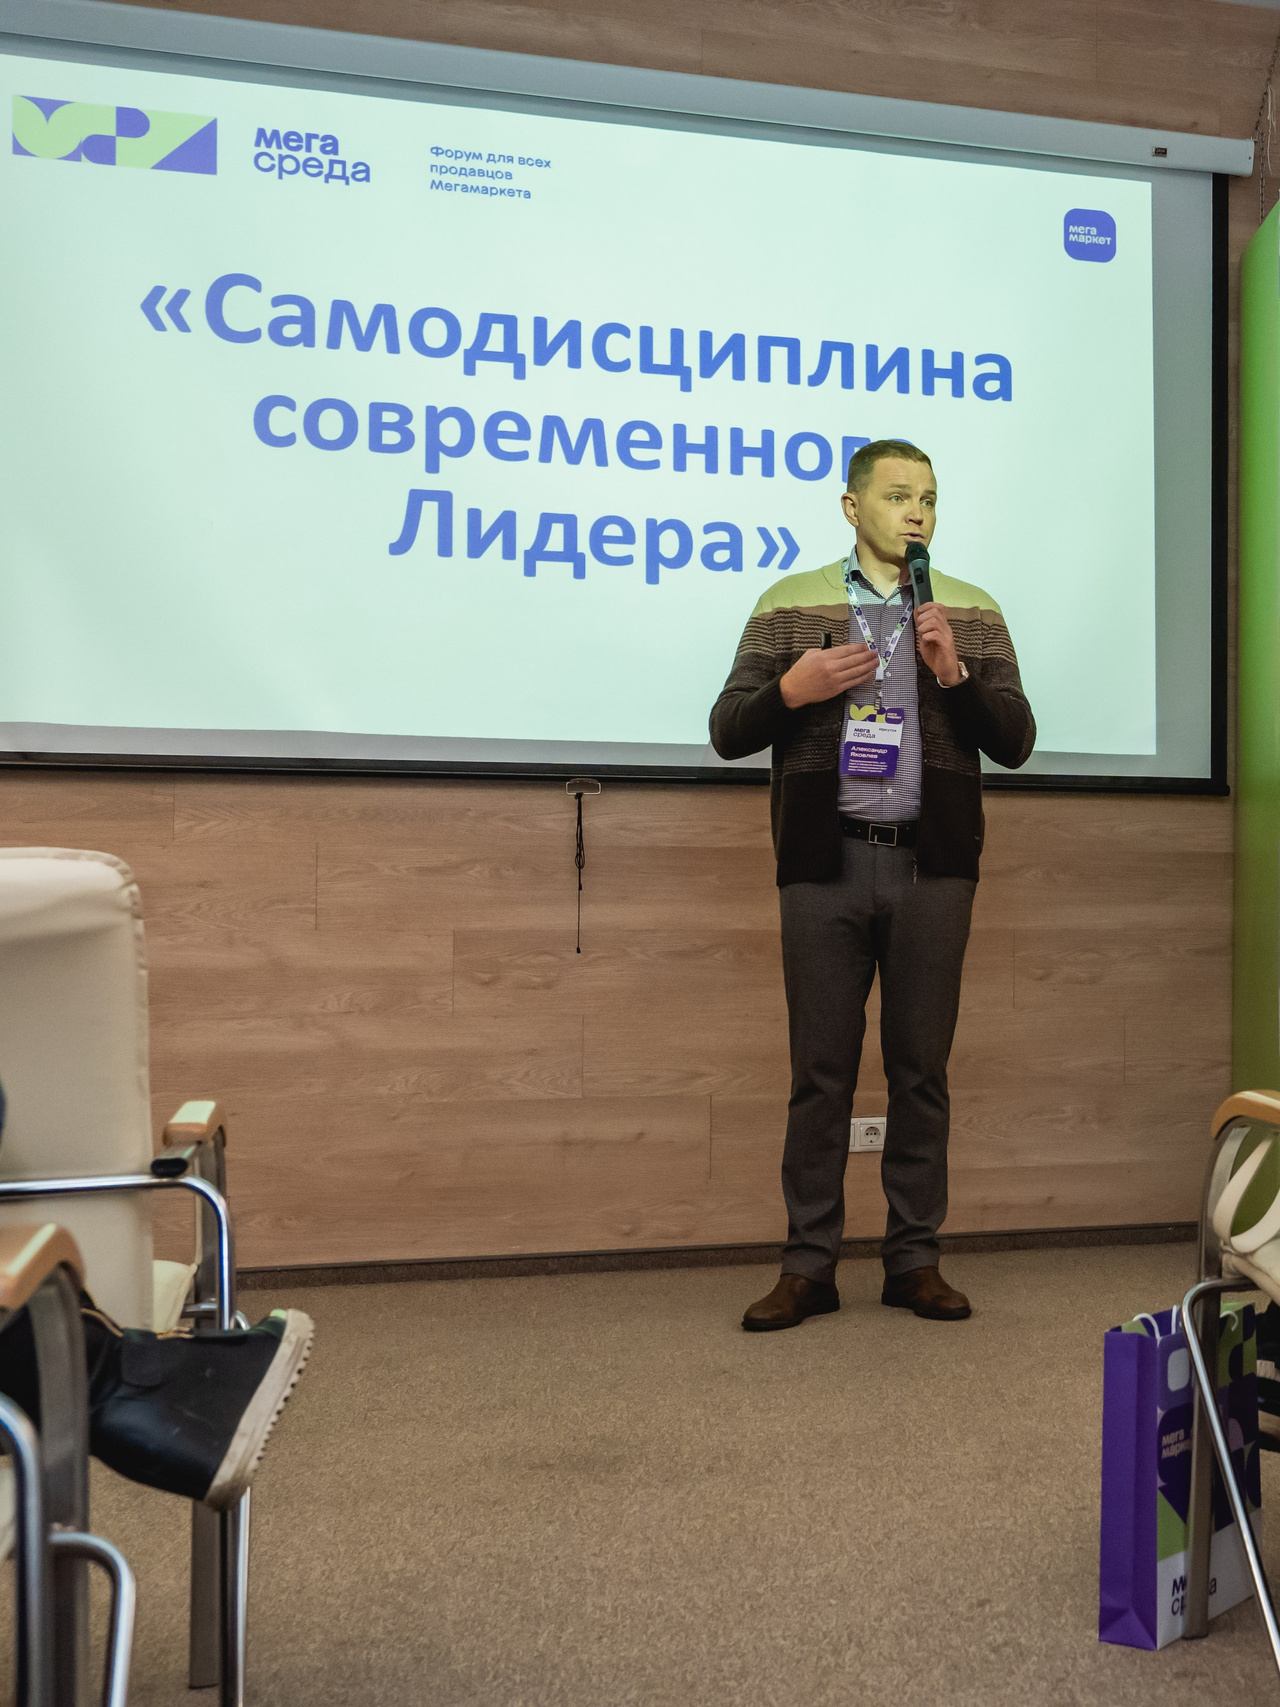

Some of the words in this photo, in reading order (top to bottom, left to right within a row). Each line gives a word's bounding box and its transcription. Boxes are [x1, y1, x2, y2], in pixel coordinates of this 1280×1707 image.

[254, 127, 339, 156] мега
[253, 150, 371, 186] среда
[429, 145, 484, 162] Форум
[485, 152, 514, 166] для
[517, 157, 552, 169] всех
[429, 163, 513, 180] продавцов
[429, 180, 532, 200] Мегамаркета
[1068, 225, 1097, 235] мега
[1068, 234, 1112, 245] маркет
[140, 272, 1014, 402] «Самодисциплина
[252, 393, 915, 485] современног
[387, 488, 801, 586] Лидера»
